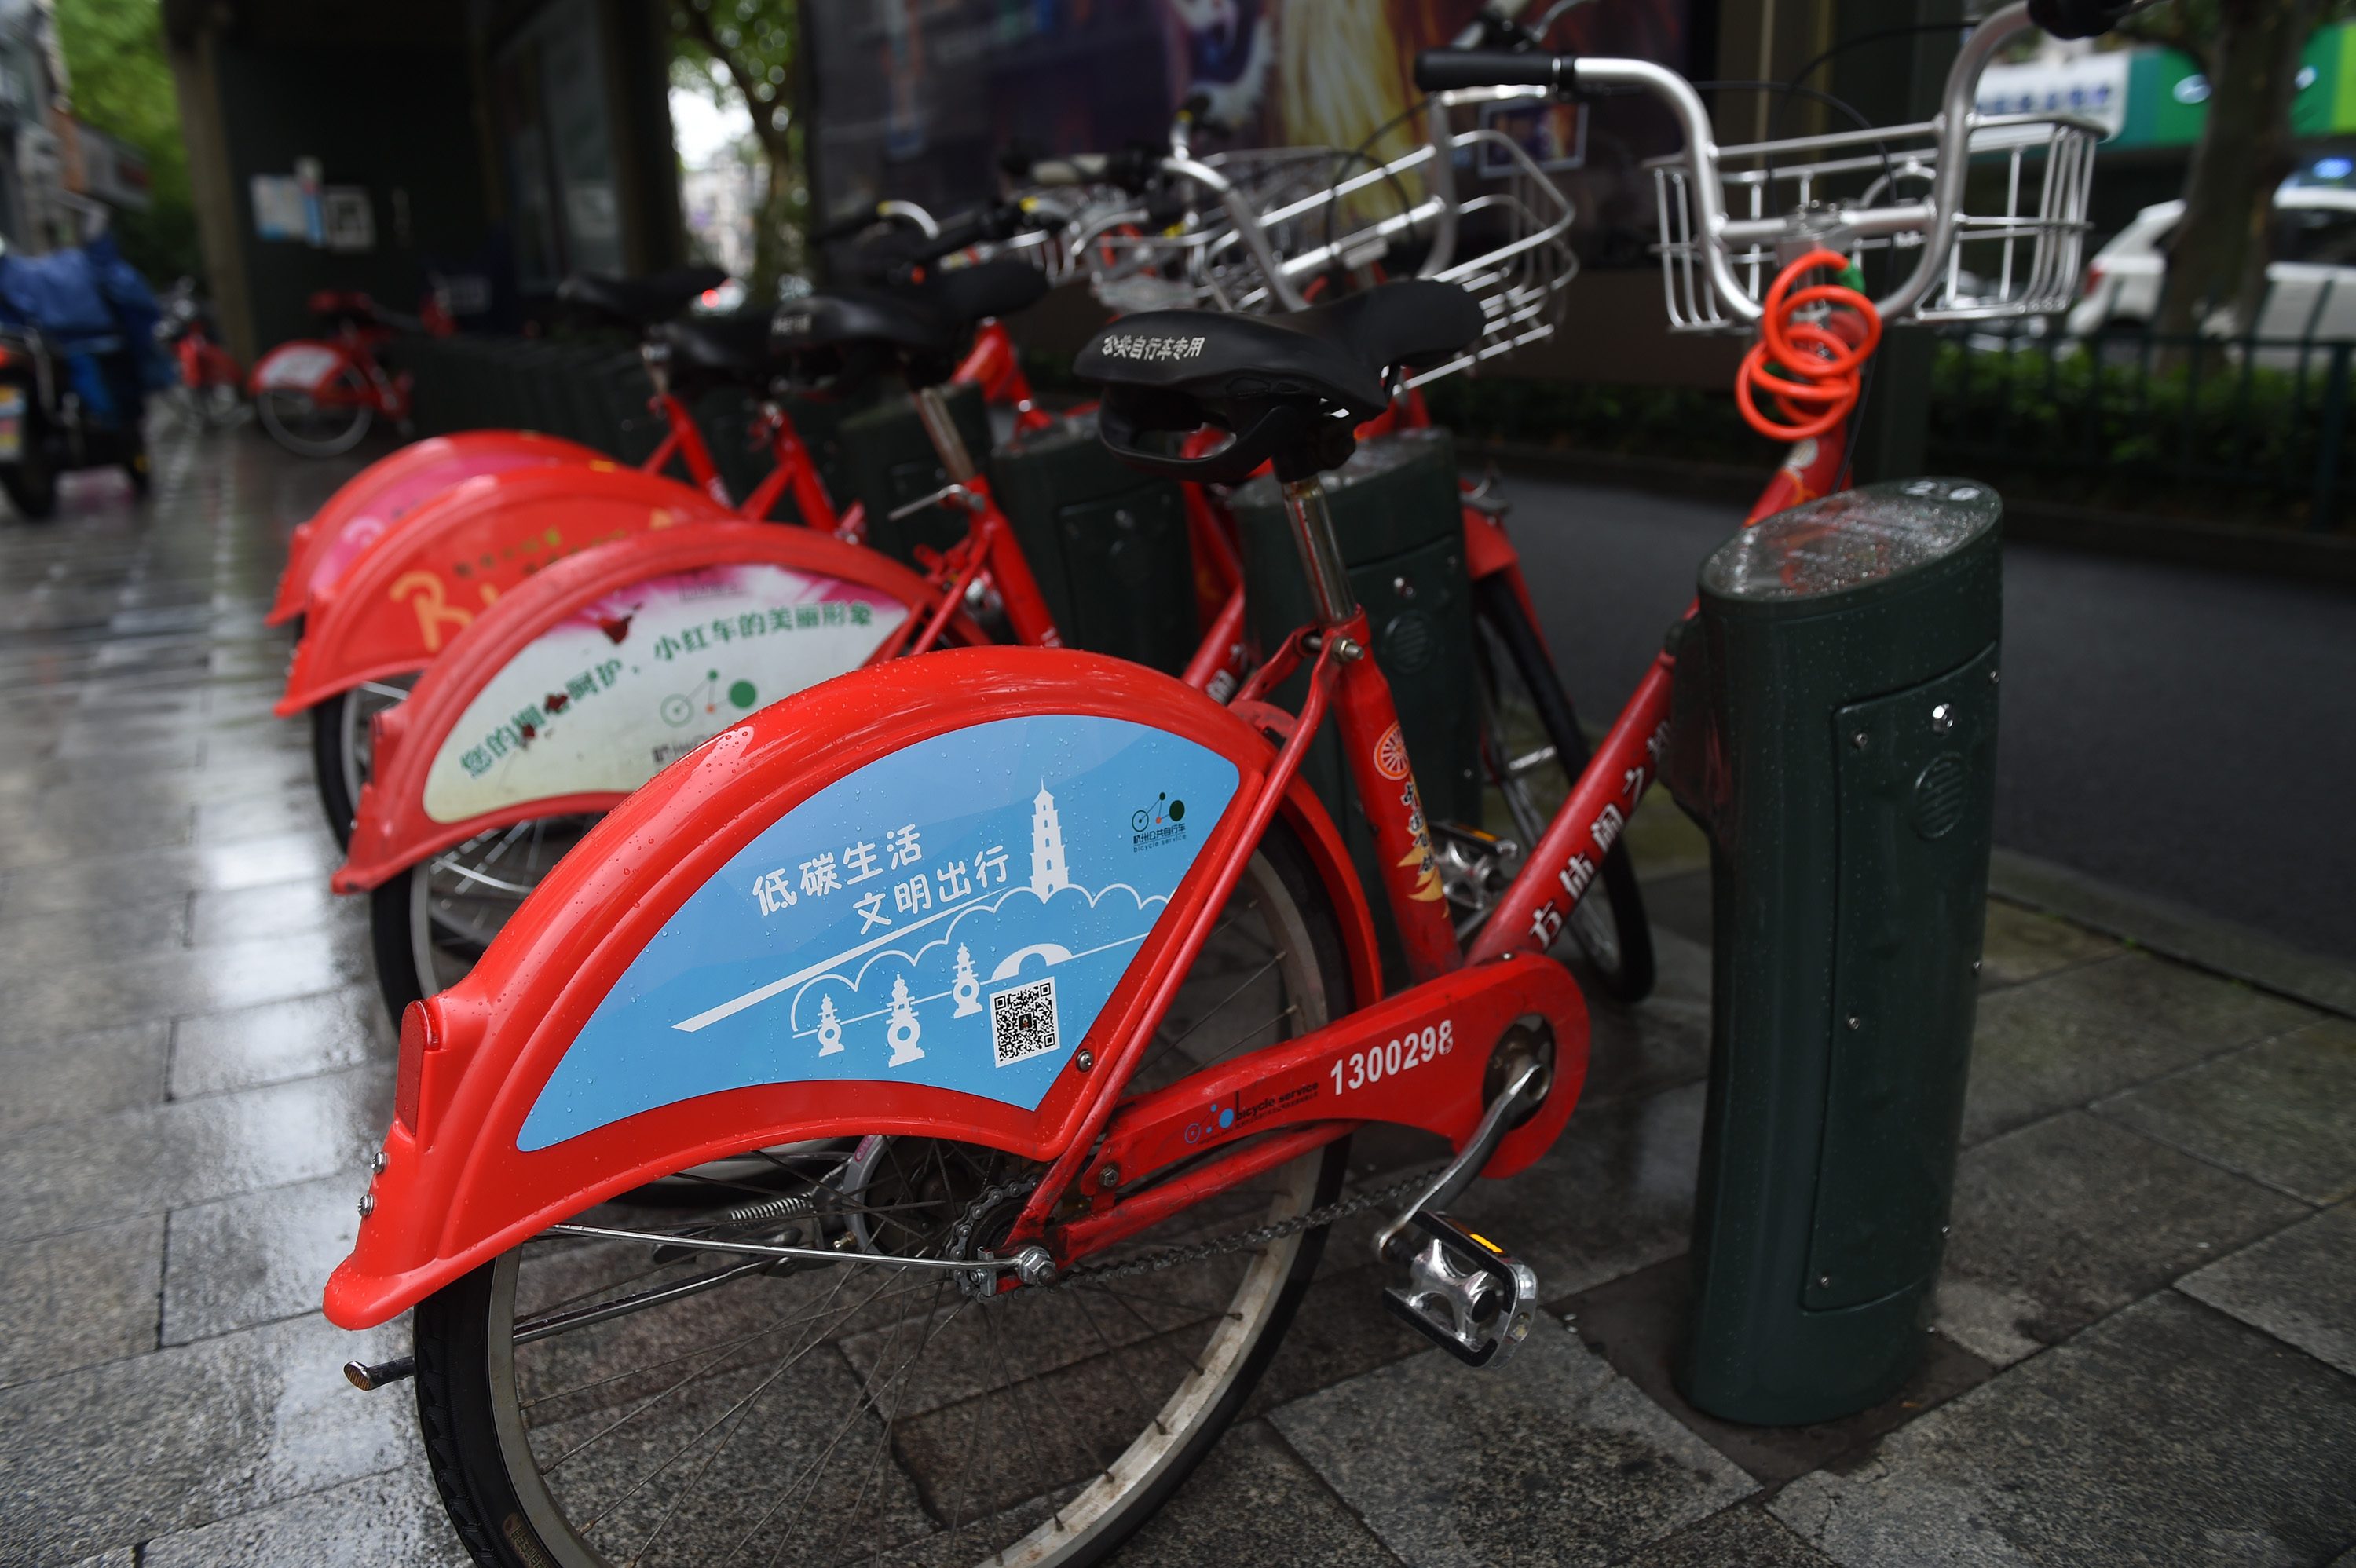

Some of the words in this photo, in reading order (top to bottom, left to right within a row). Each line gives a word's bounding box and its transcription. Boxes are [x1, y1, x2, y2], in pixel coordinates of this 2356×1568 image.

[752, 824, 922, 916] 低碳生活
[1133, 841, 1159, 853] bicycle
[1162, 834, 1187, 846] service
[853, 845, 1008, 934] 文明出行
[1330, 1019, 1453, 1095] 1300298
[1235, 1090, 1275, 1121] bicycle
[1279, 1082, 1319, 1103] service
